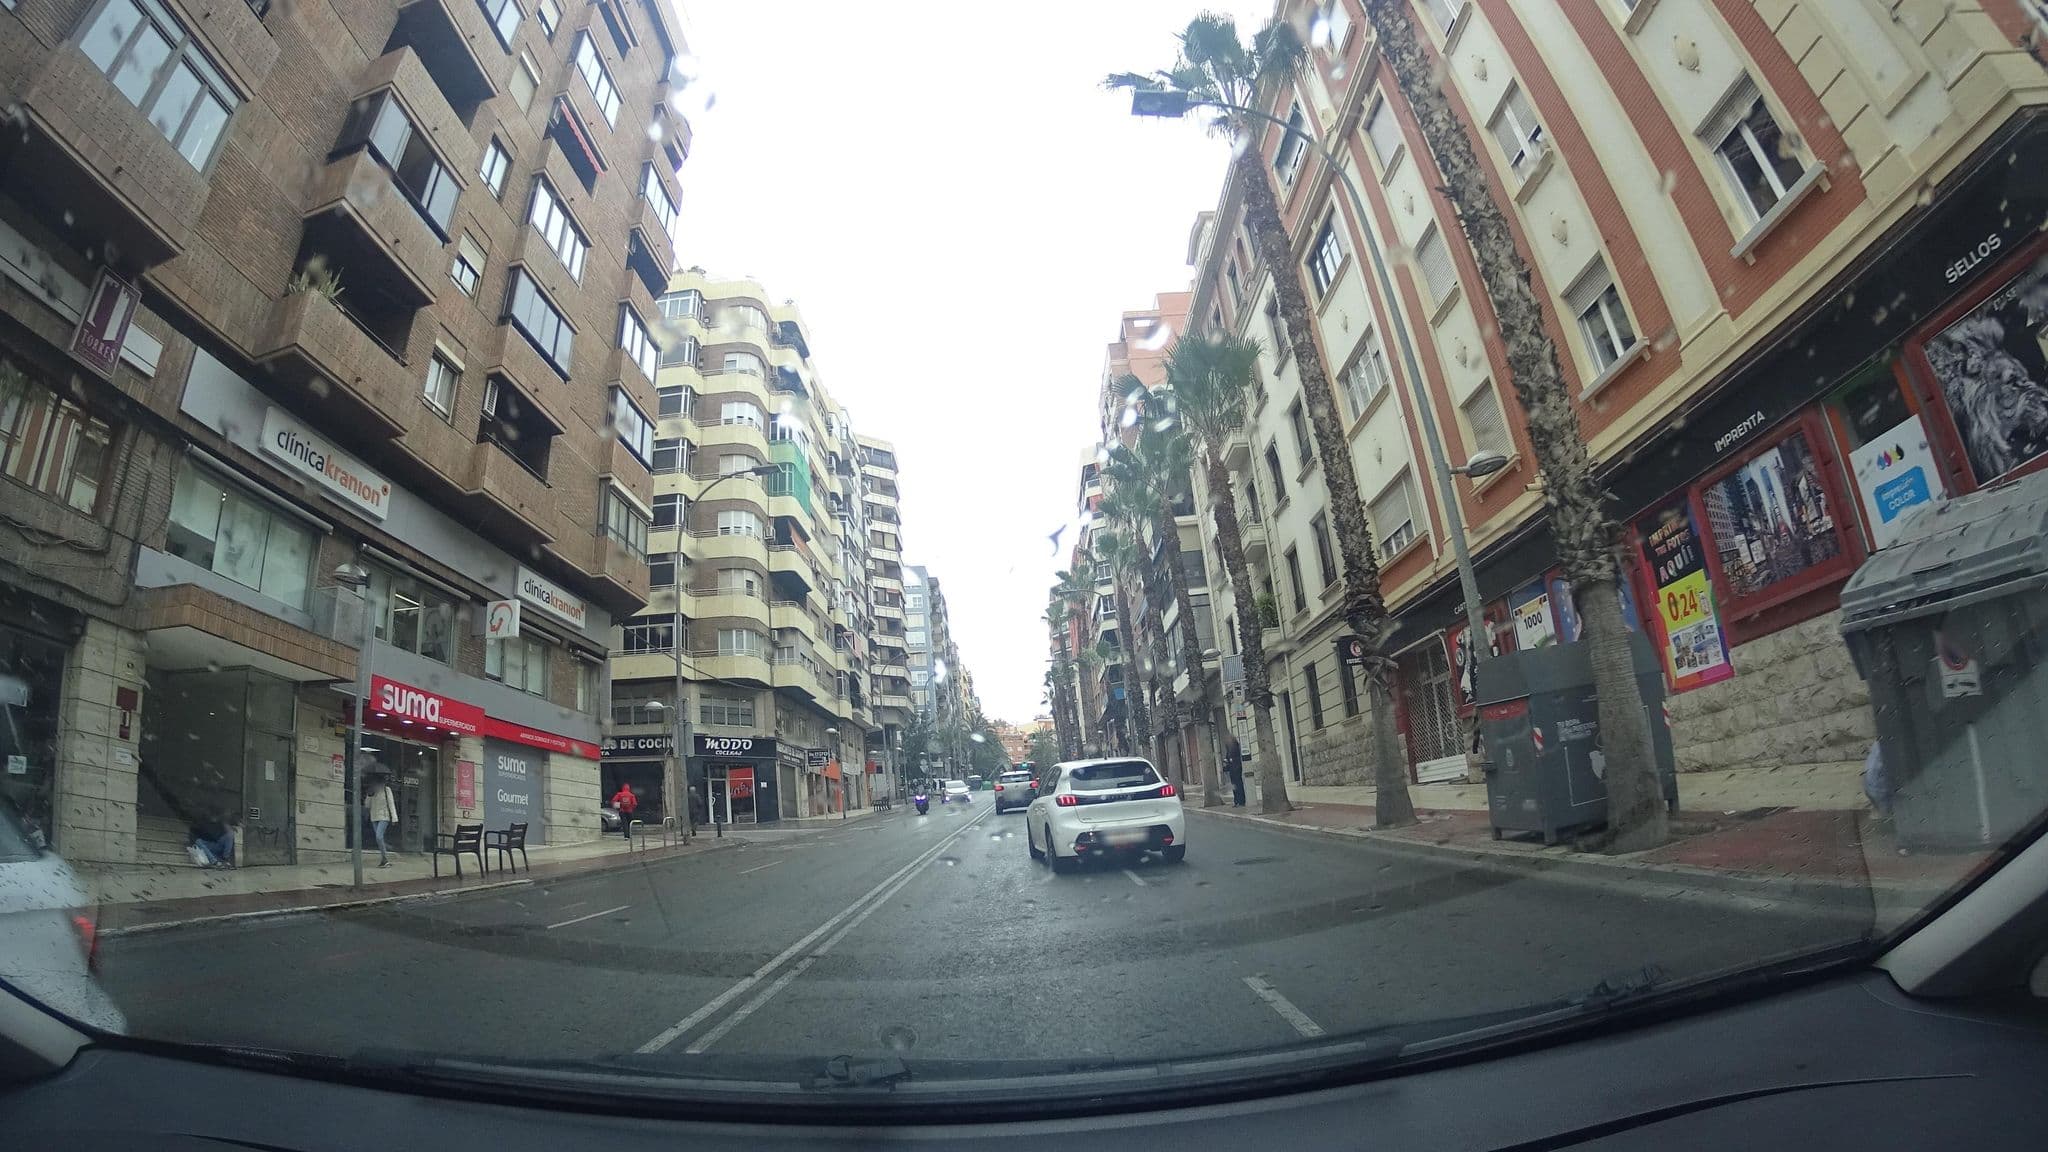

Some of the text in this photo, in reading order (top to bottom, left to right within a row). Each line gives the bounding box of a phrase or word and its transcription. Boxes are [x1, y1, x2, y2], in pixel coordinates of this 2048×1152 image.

[1945, 233, 2002, 284] SELLOS
[81, 328, 116, 363] TORRES
[1714, 410, 1766, 453] IMPRENTA
[1888, 489, 1917, 511] COLOR
[1524, 611, 1543, 630] 1000
[382, 683, 440, 723] suma
[620, 739, 636, 750] DE
[638, 737, 673, 750] COCIN
[705, 738, 753, 750] MODO
[498, 755, 526, 775] suma
[497, 788, 529, 806] Gourmet
